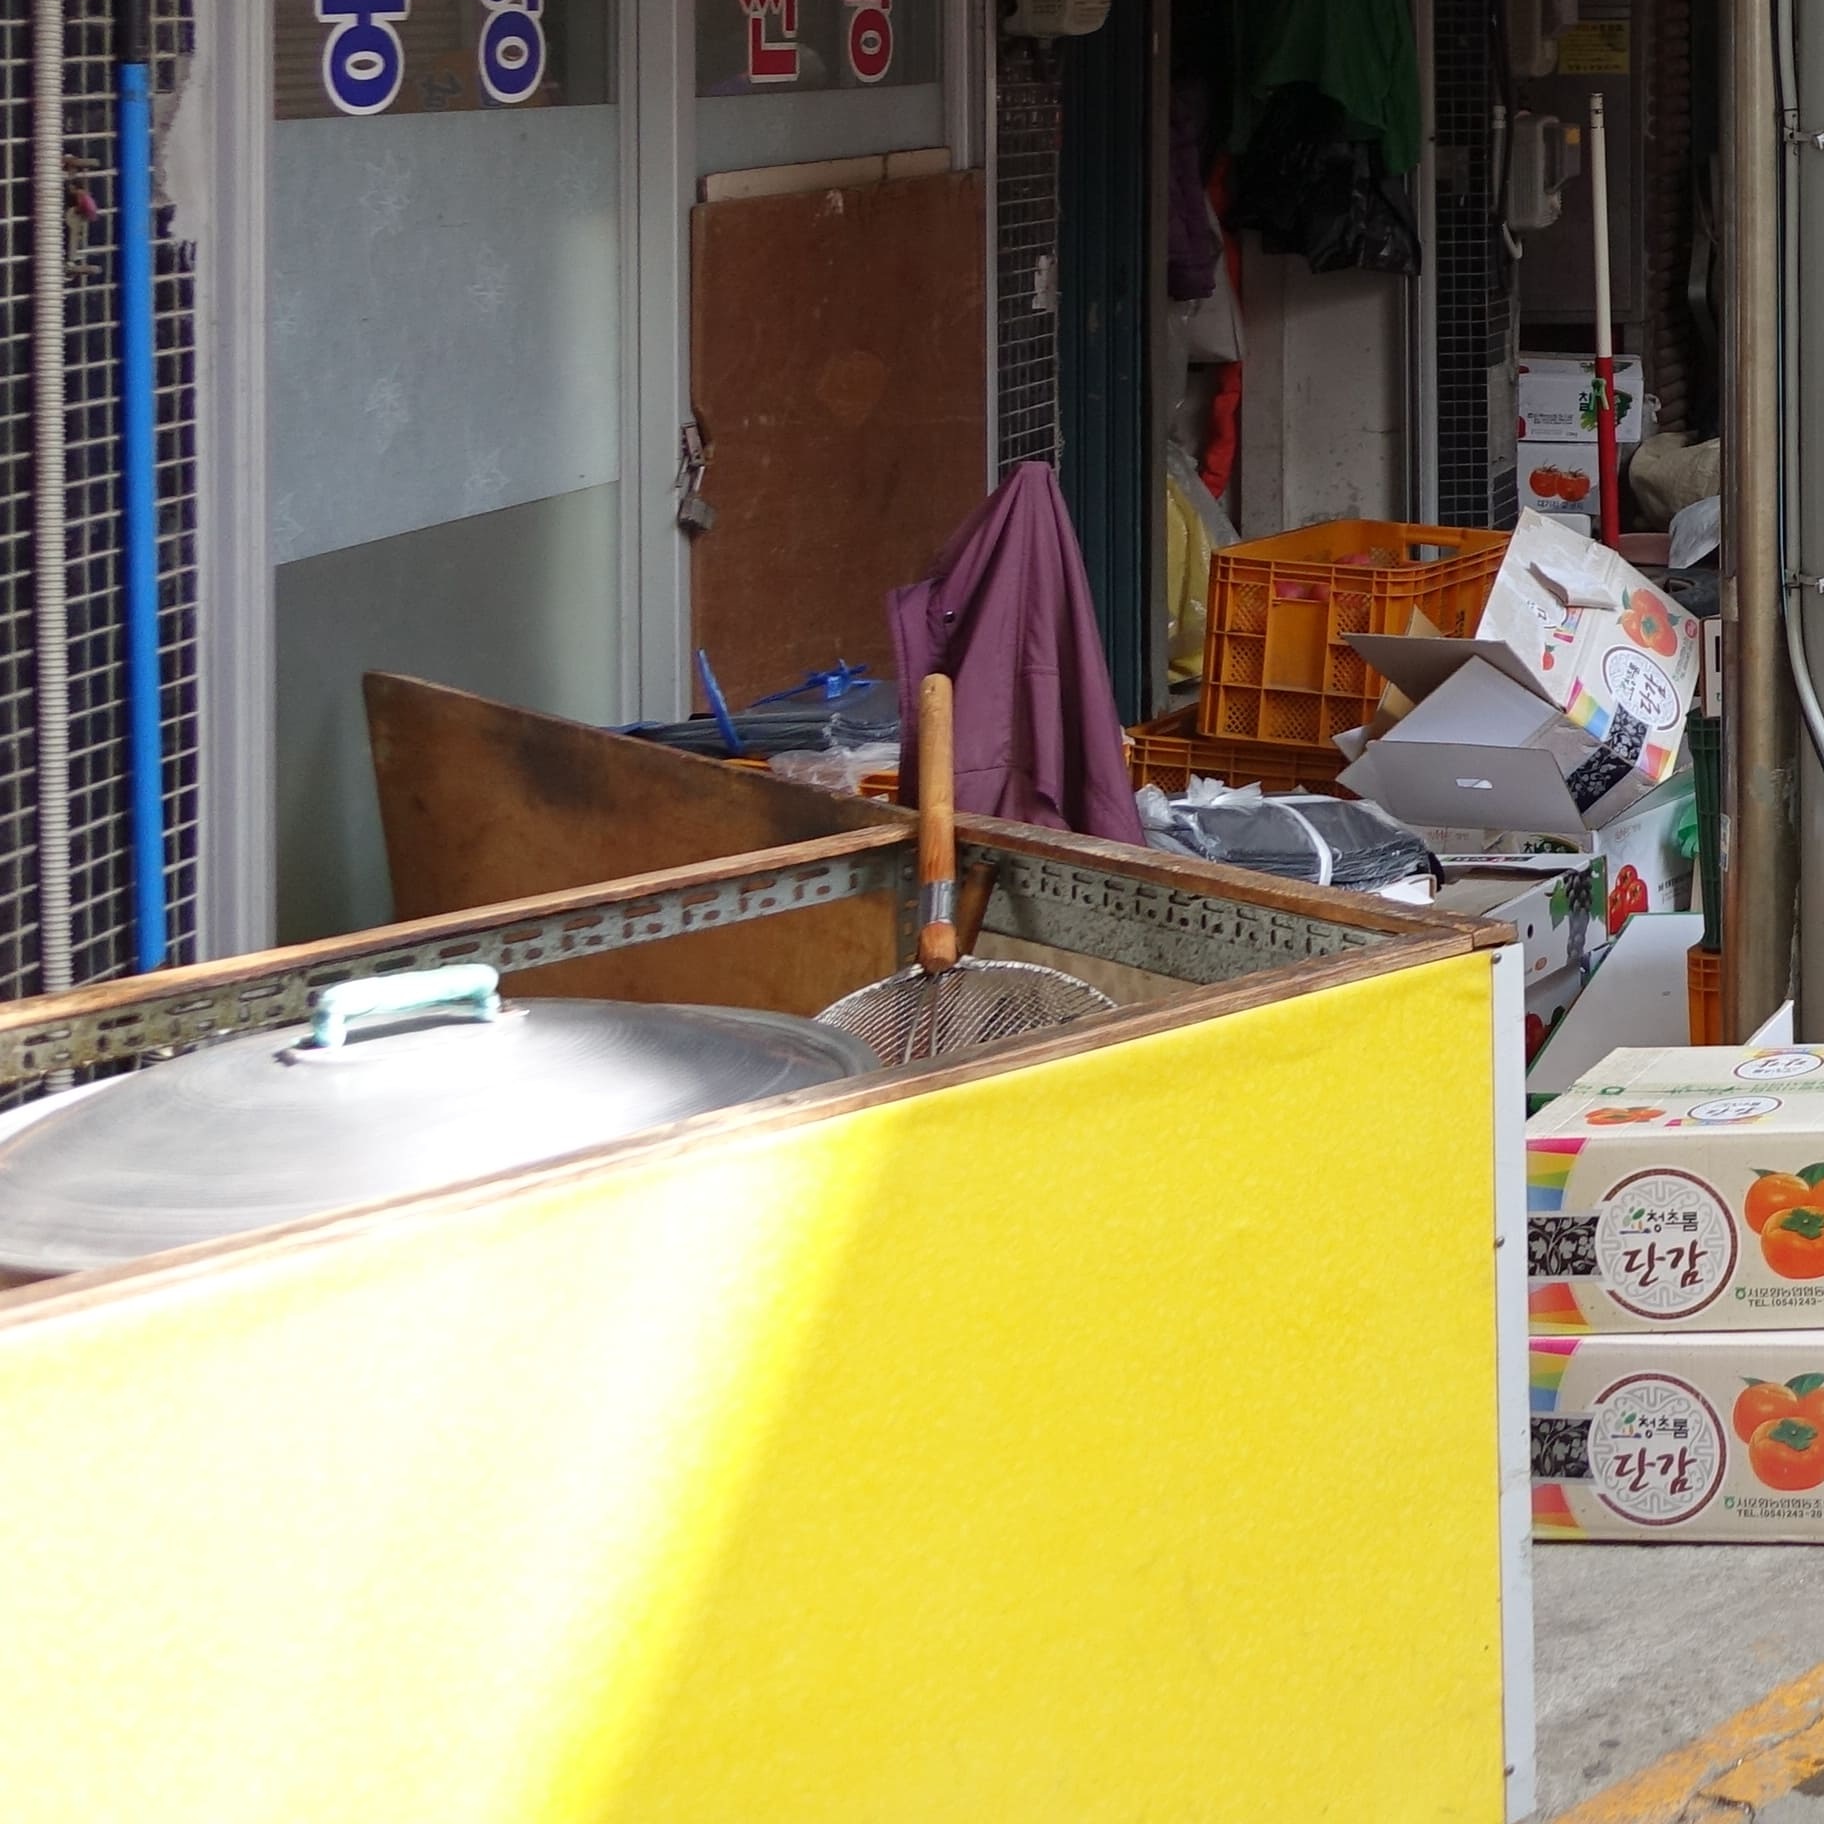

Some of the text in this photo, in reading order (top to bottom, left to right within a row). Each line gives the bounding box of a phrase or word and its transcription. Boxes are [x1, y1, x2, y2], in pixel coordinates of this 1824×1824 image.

[1646, 1209, 1699, 1234] 청초롬
[1623, 1238, 1710, 1290] 단감
[1638, 1415, 1690, 1439] 청초롬
[1613, 1446, 1699, 1496] 단감
